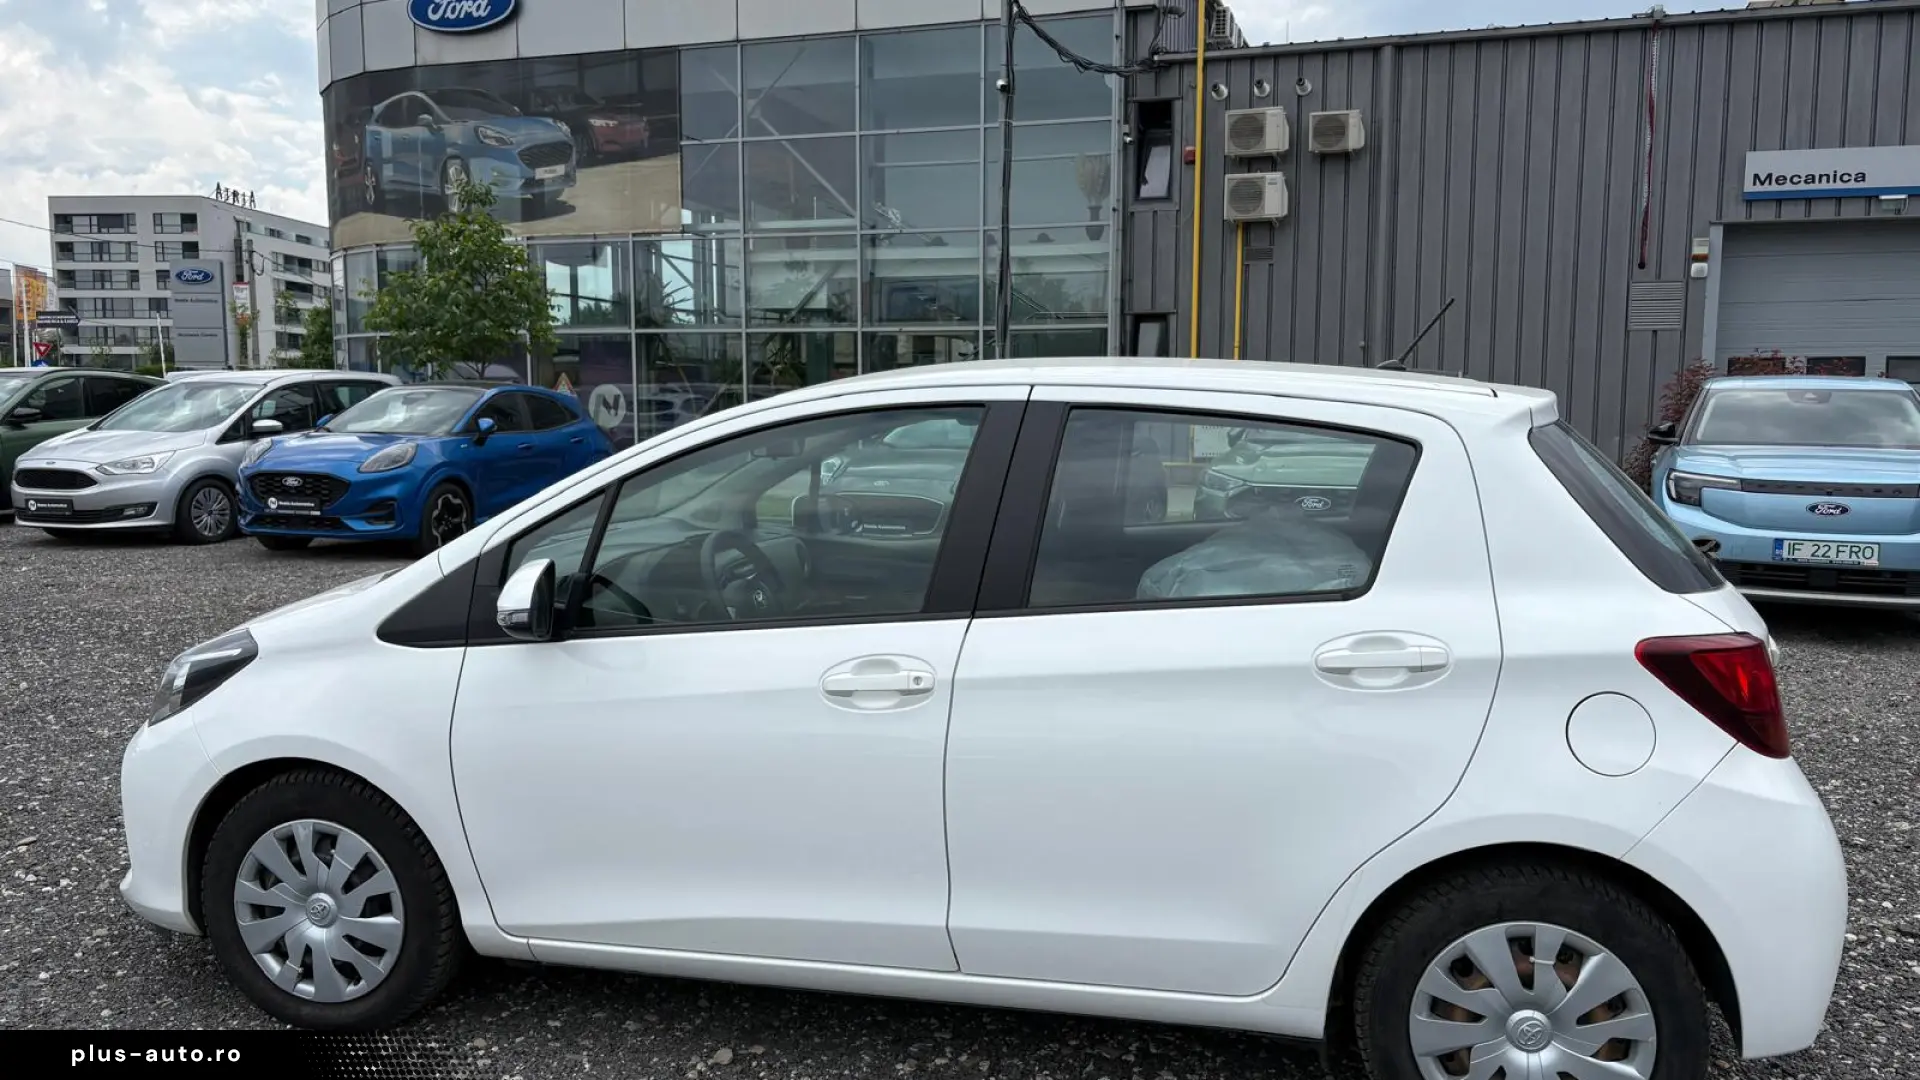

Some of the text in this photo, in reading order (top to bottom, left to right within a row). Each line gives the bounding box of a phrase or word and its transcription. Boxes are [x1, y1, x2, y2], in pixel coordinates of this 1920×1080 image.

[427, 0, 492, 20] Ford
[1752, 170, 1867, 187] Mecanica
[1787, 542, 1804, 557] IF
[1810, 544, 1832, 559] 22
[1835, 545, 1875, 560] FRO
